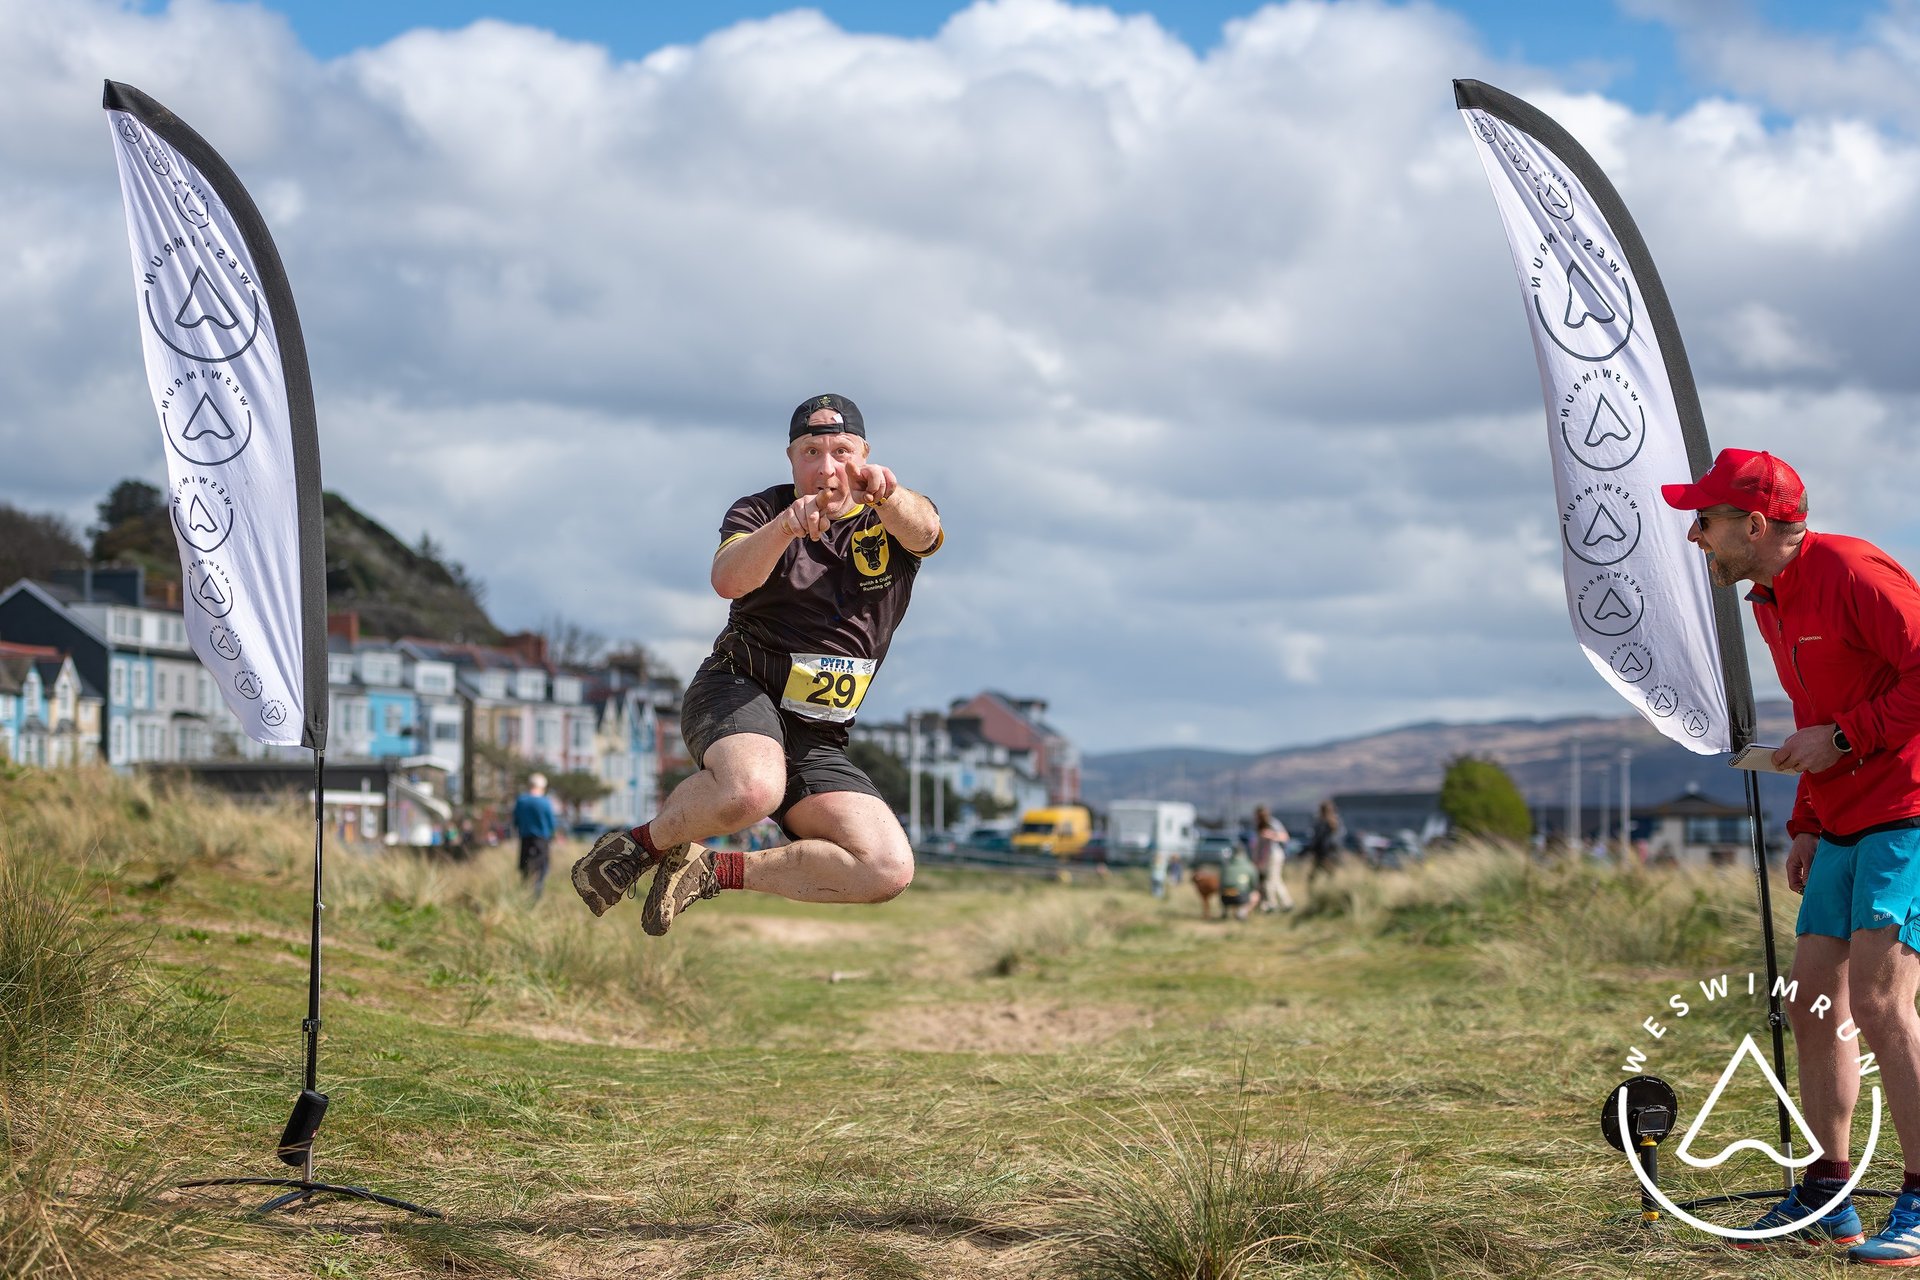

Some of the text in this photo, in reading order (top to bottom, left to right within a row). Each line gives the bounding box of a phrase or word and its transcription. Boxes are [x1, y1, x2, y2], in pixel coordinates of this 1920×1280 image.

[820, 657, 854, 670] DYFI X
[806, 671, 856, 708] 29
